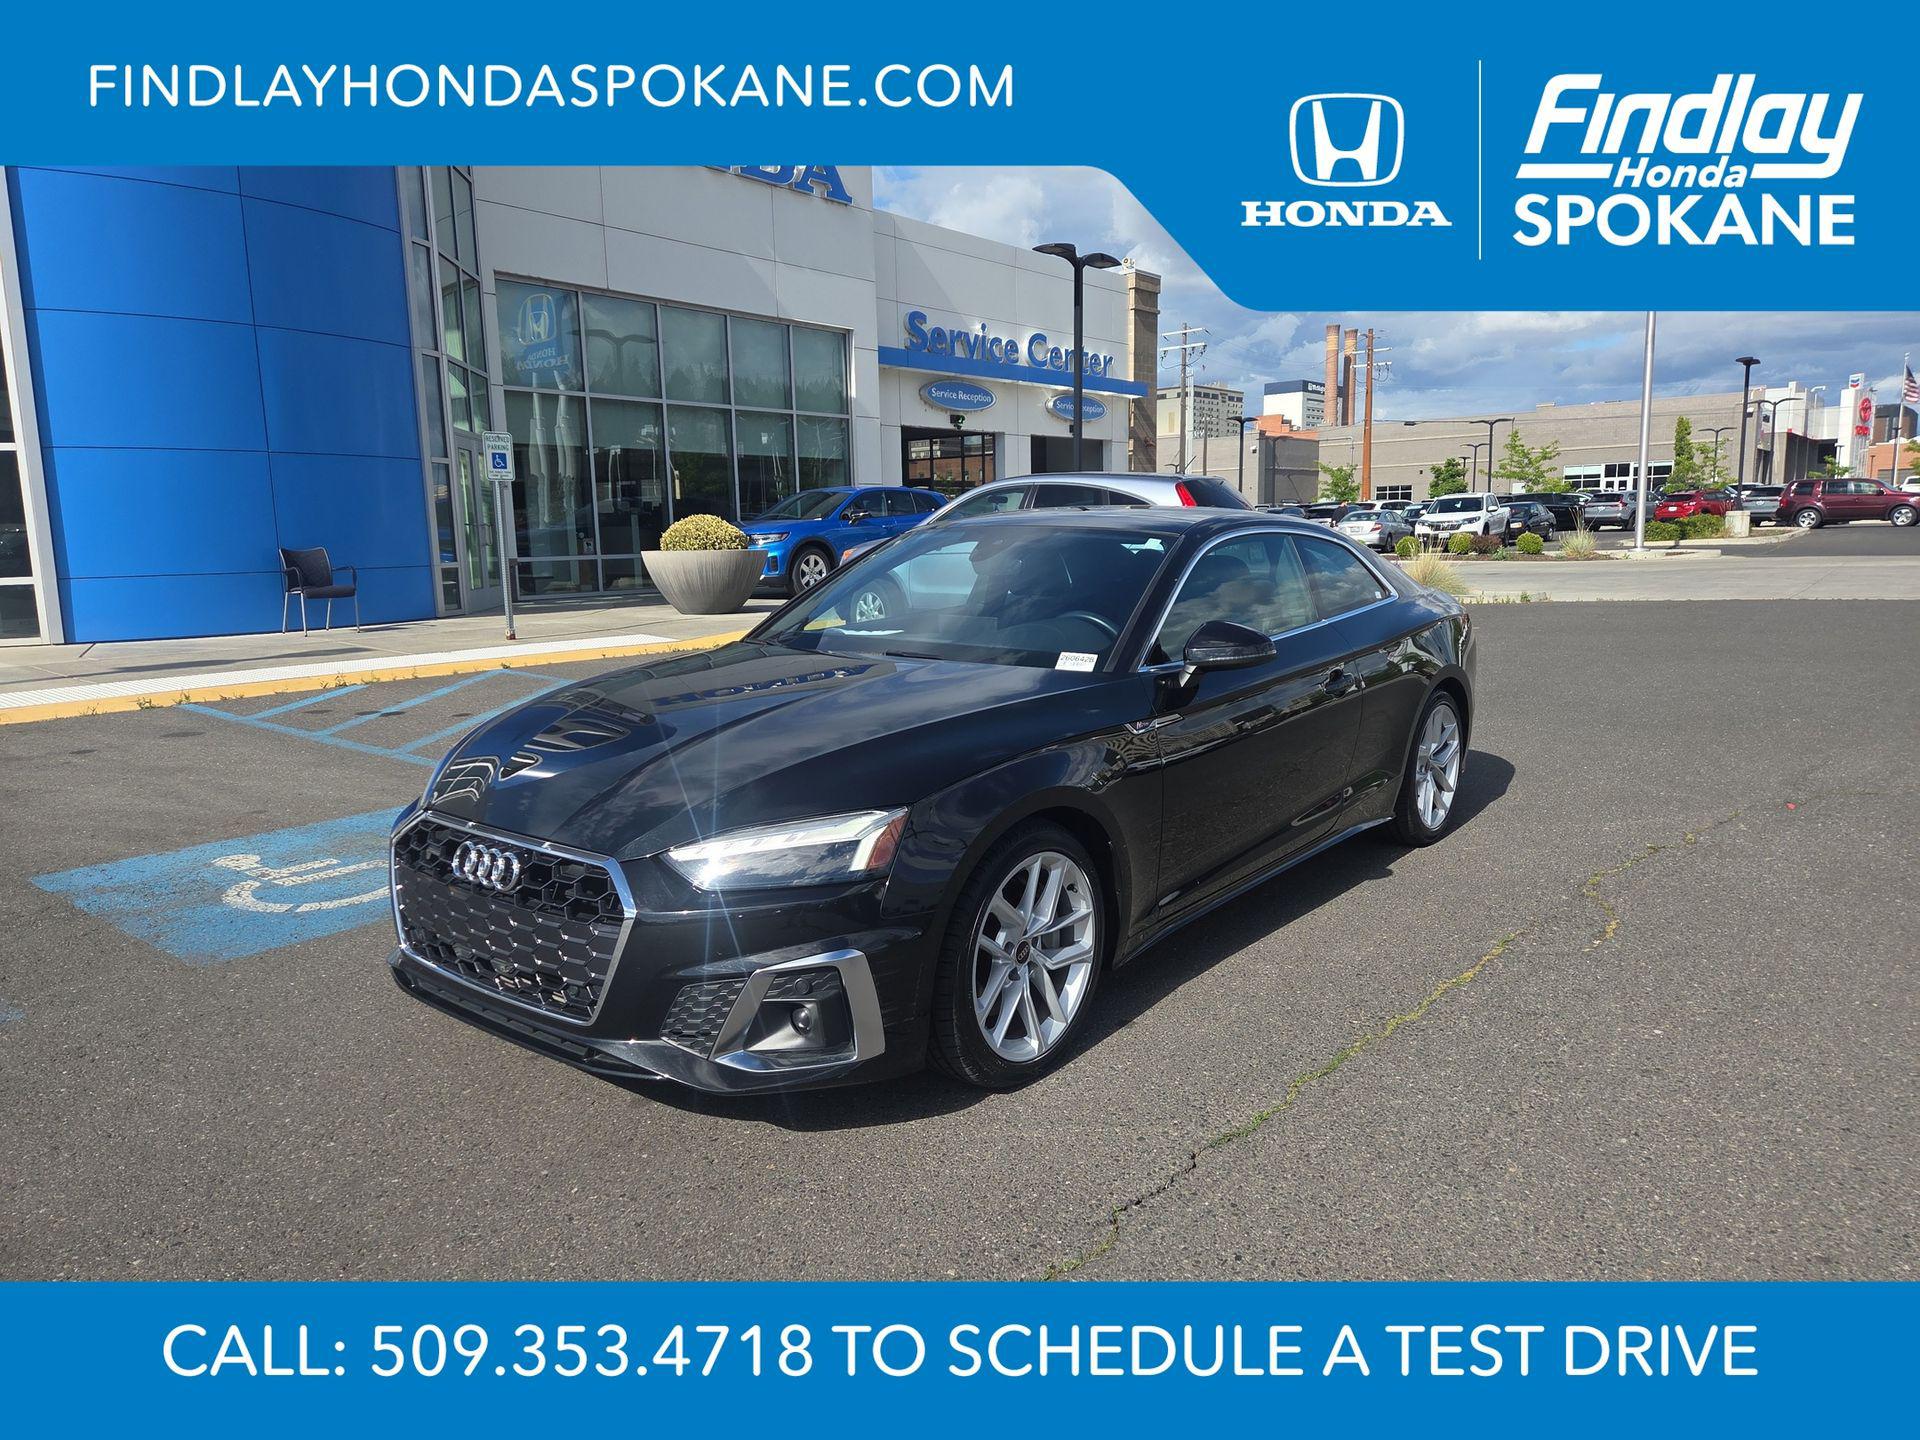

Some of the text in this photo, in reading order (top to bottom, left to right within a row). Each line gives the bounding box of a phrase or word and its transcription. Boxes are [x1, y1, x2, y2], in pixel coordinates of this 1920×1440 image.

[904, 310, 1115, 378] Service Center
[931, 387, 992, 404] Service Reception
[1056, 401, 1075, 410] Servic
[487, 443, 510, 451] PARKING
